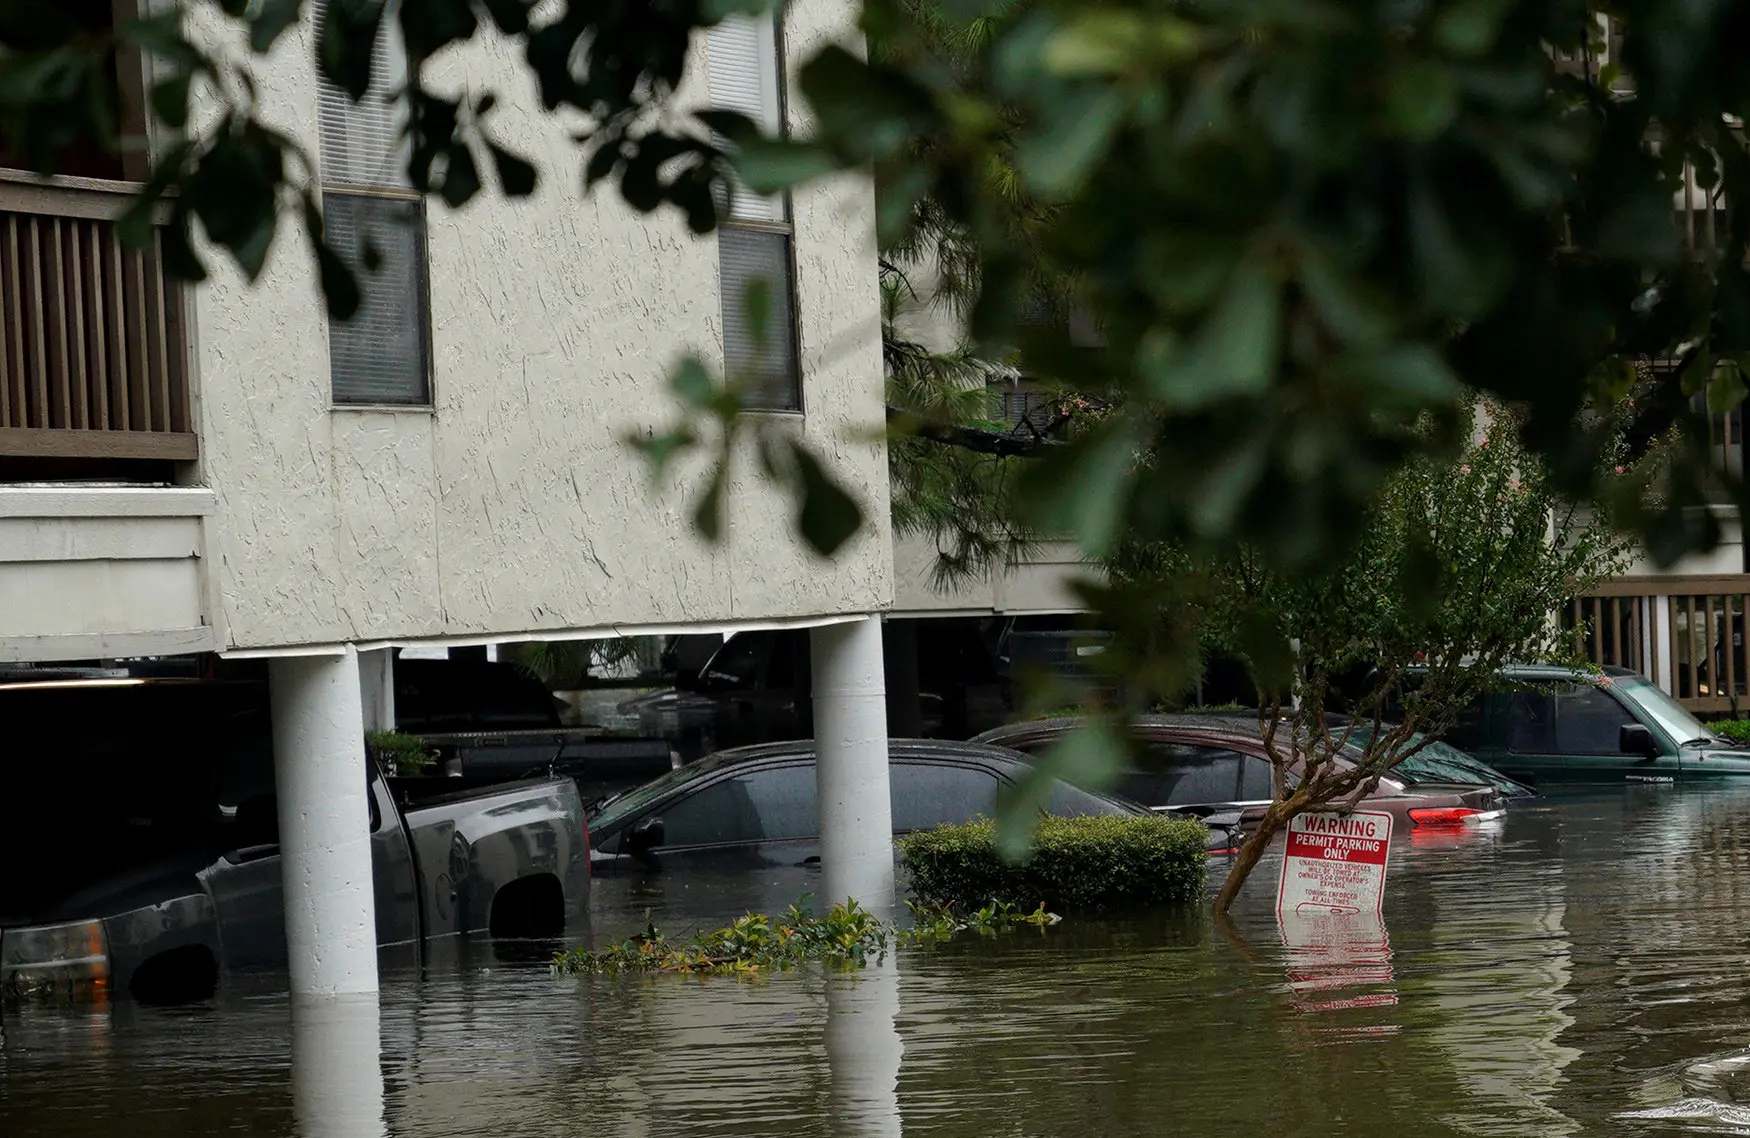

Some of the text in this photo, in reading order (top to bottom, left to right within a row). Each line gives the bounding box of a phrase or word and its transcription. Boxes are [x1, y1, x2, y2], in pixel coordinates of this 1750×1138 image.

[1305, 816, 1376, 837] WARNING
[1296, 834, 1380, 852] PERMIT PARKING
[1324, 848, 1350, 860] ONLY
[1299, 860, 1371, 872] UNAUTHORIZED VEHICLES
[1298, 872, 1323, 880] OWNER'S
[1334, 876, 1369, 884] OPERATOR'S
[1320, 881, 1345, 889] EXPENSE
[1328, 891, 1358, 899] ENFORCED
